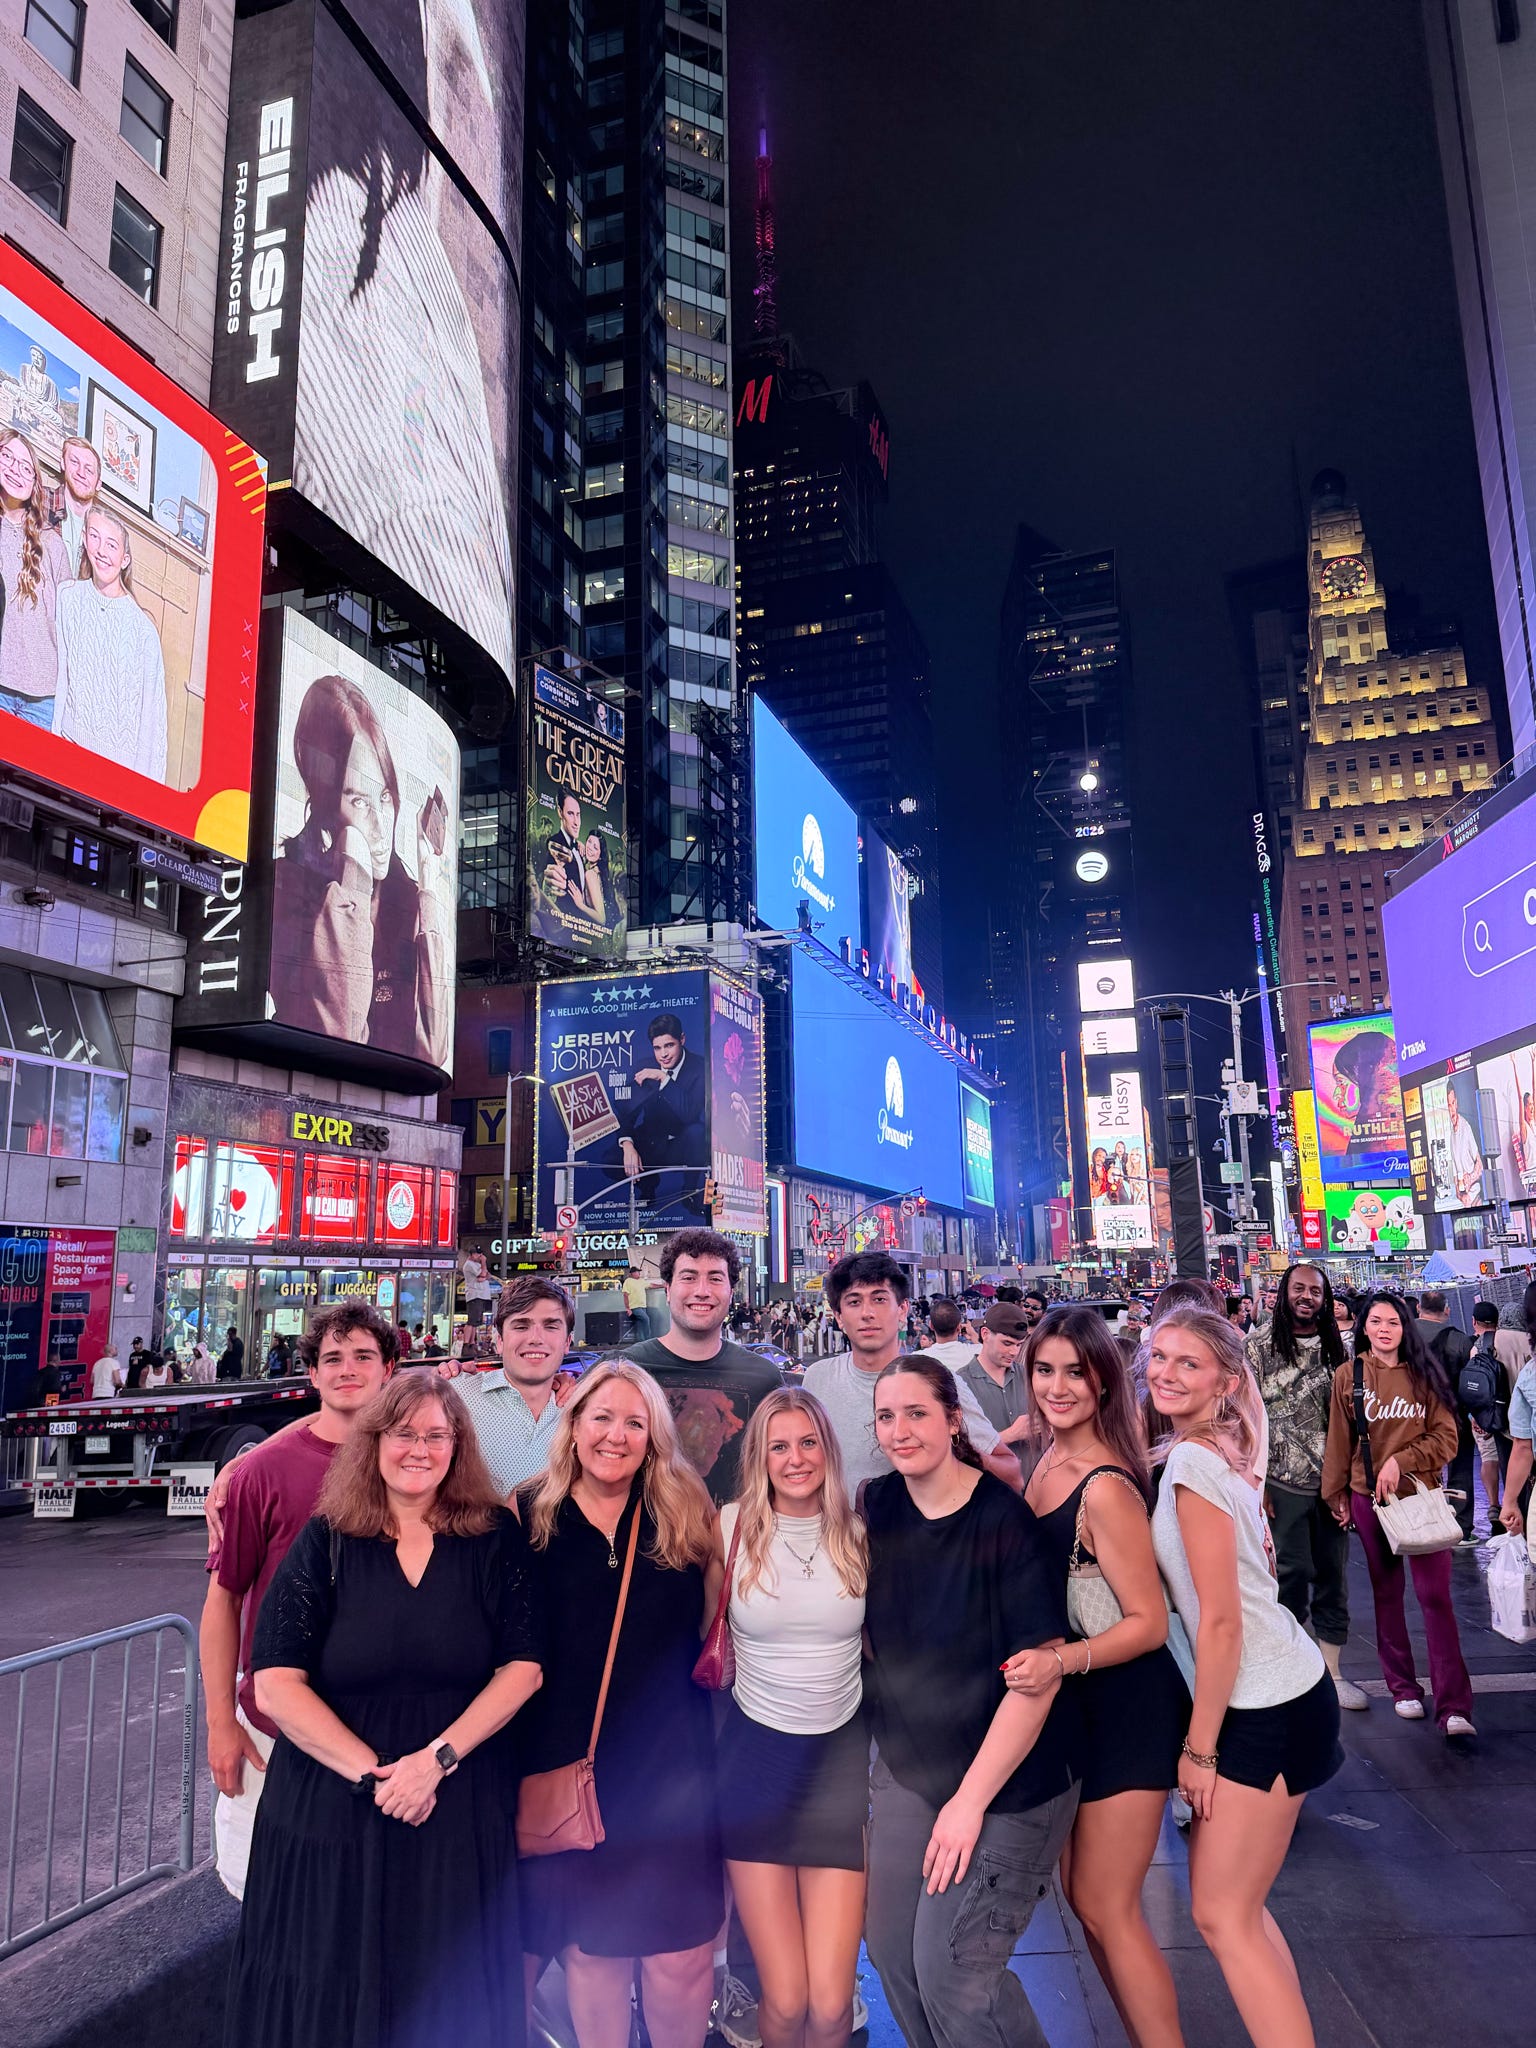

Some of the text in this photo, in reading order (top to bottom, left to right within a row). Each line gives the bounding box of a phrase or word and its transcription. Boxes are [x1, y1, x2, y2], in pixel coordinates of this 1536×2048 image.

[227, 161, 248, 334] FRAGRANCES
[246, 97, 294, 383] EILISH
[540, 681, 579, 707] CORBIN BLEU
[543, 676, 577, 698] NOW STARRING
[534, 702, 624, 755] THE PARTY'S ROARING ON BROADWAY
[535, 718, 625, 785] THE GREAT
[546, 753, 615, 805] GATSBY
[1075, 825, 1105, 838] 2026
[1454, 811, 1480, 837] MARRIOTT
[1253, 812, 1271, 873] DRAGOS
[1455, 825, 1479, 846] MARQUIS
[181, 873, 218, 892] SPECTACOLOR
[566, 914, 591, 927] BROADWAY
[578, 925, 604, 938] BROADWAY
[1263, 878, 1281, 985] Safeguarding Civilization
[557, 1007, 589, 1017] HELLUVA
[591, 1004, 618, 1014] GOOD
[621, 1002, 638, 1011] TIME
[713, 992, 734, 1020] WORLD
[734, 1005, 752, 1031] COULD
[1276, 990, 1286, 1033] dragos.com
[551, 1029, 636, 1049] JEREMY
[1407, 1040, 1426, 1057] TikTok
[551, 1045, 633, 1073] JORDAN
[609, 1073, 627, 1087] BOBBY
[563, 1084, 592, 1108] JUST
[614, 1087, 632, 1100] DARIN
[1115, 1077, 1131, 1126] Pussy
[565, 1097, 609, 1122] TIME
[292, 1112, 390, 1151] EXPRESS
[584, 1135, 597, 1144] NEW
[597, 1125, 617, 1137] MUSICAL
[1302, 1150, 1318, 1160] KING
[1410, 1156, 1428, 1175] PERFECT
[218, 1184, 228, 1205] I
[322, 1197, 337, 1216] CAN
[584, 1212, 602, 1220] NOW
[617, 1210, 659, 1218] BRODWAY
[211, 1209, 245, 1237] NY
[571, 1233, 658, 1251] UGGAGE
[1102, 1227, 1147, 1241] PUNK
[55, 1241, 87, 1253] Retail/
[54, 1253, 106, 1264] Restaurant
[576, 1260, 603, 1268] SONY
[53, 1264, 98, 1277] Space for
[52, 1275, 80, 1286] Lease
[281, 1282, 318, 1296] GIFTS
[335, 1283, 378, 1296] LUGGAGE
[0, 1286, 38, 1303] DWAY
[50, 1423, 76, 1434] 24360
[105, 1421, 129, 1429] Legend
[38, 1489, 73, 1500] HALE
[172, 1486, 210, 1497] HALE
